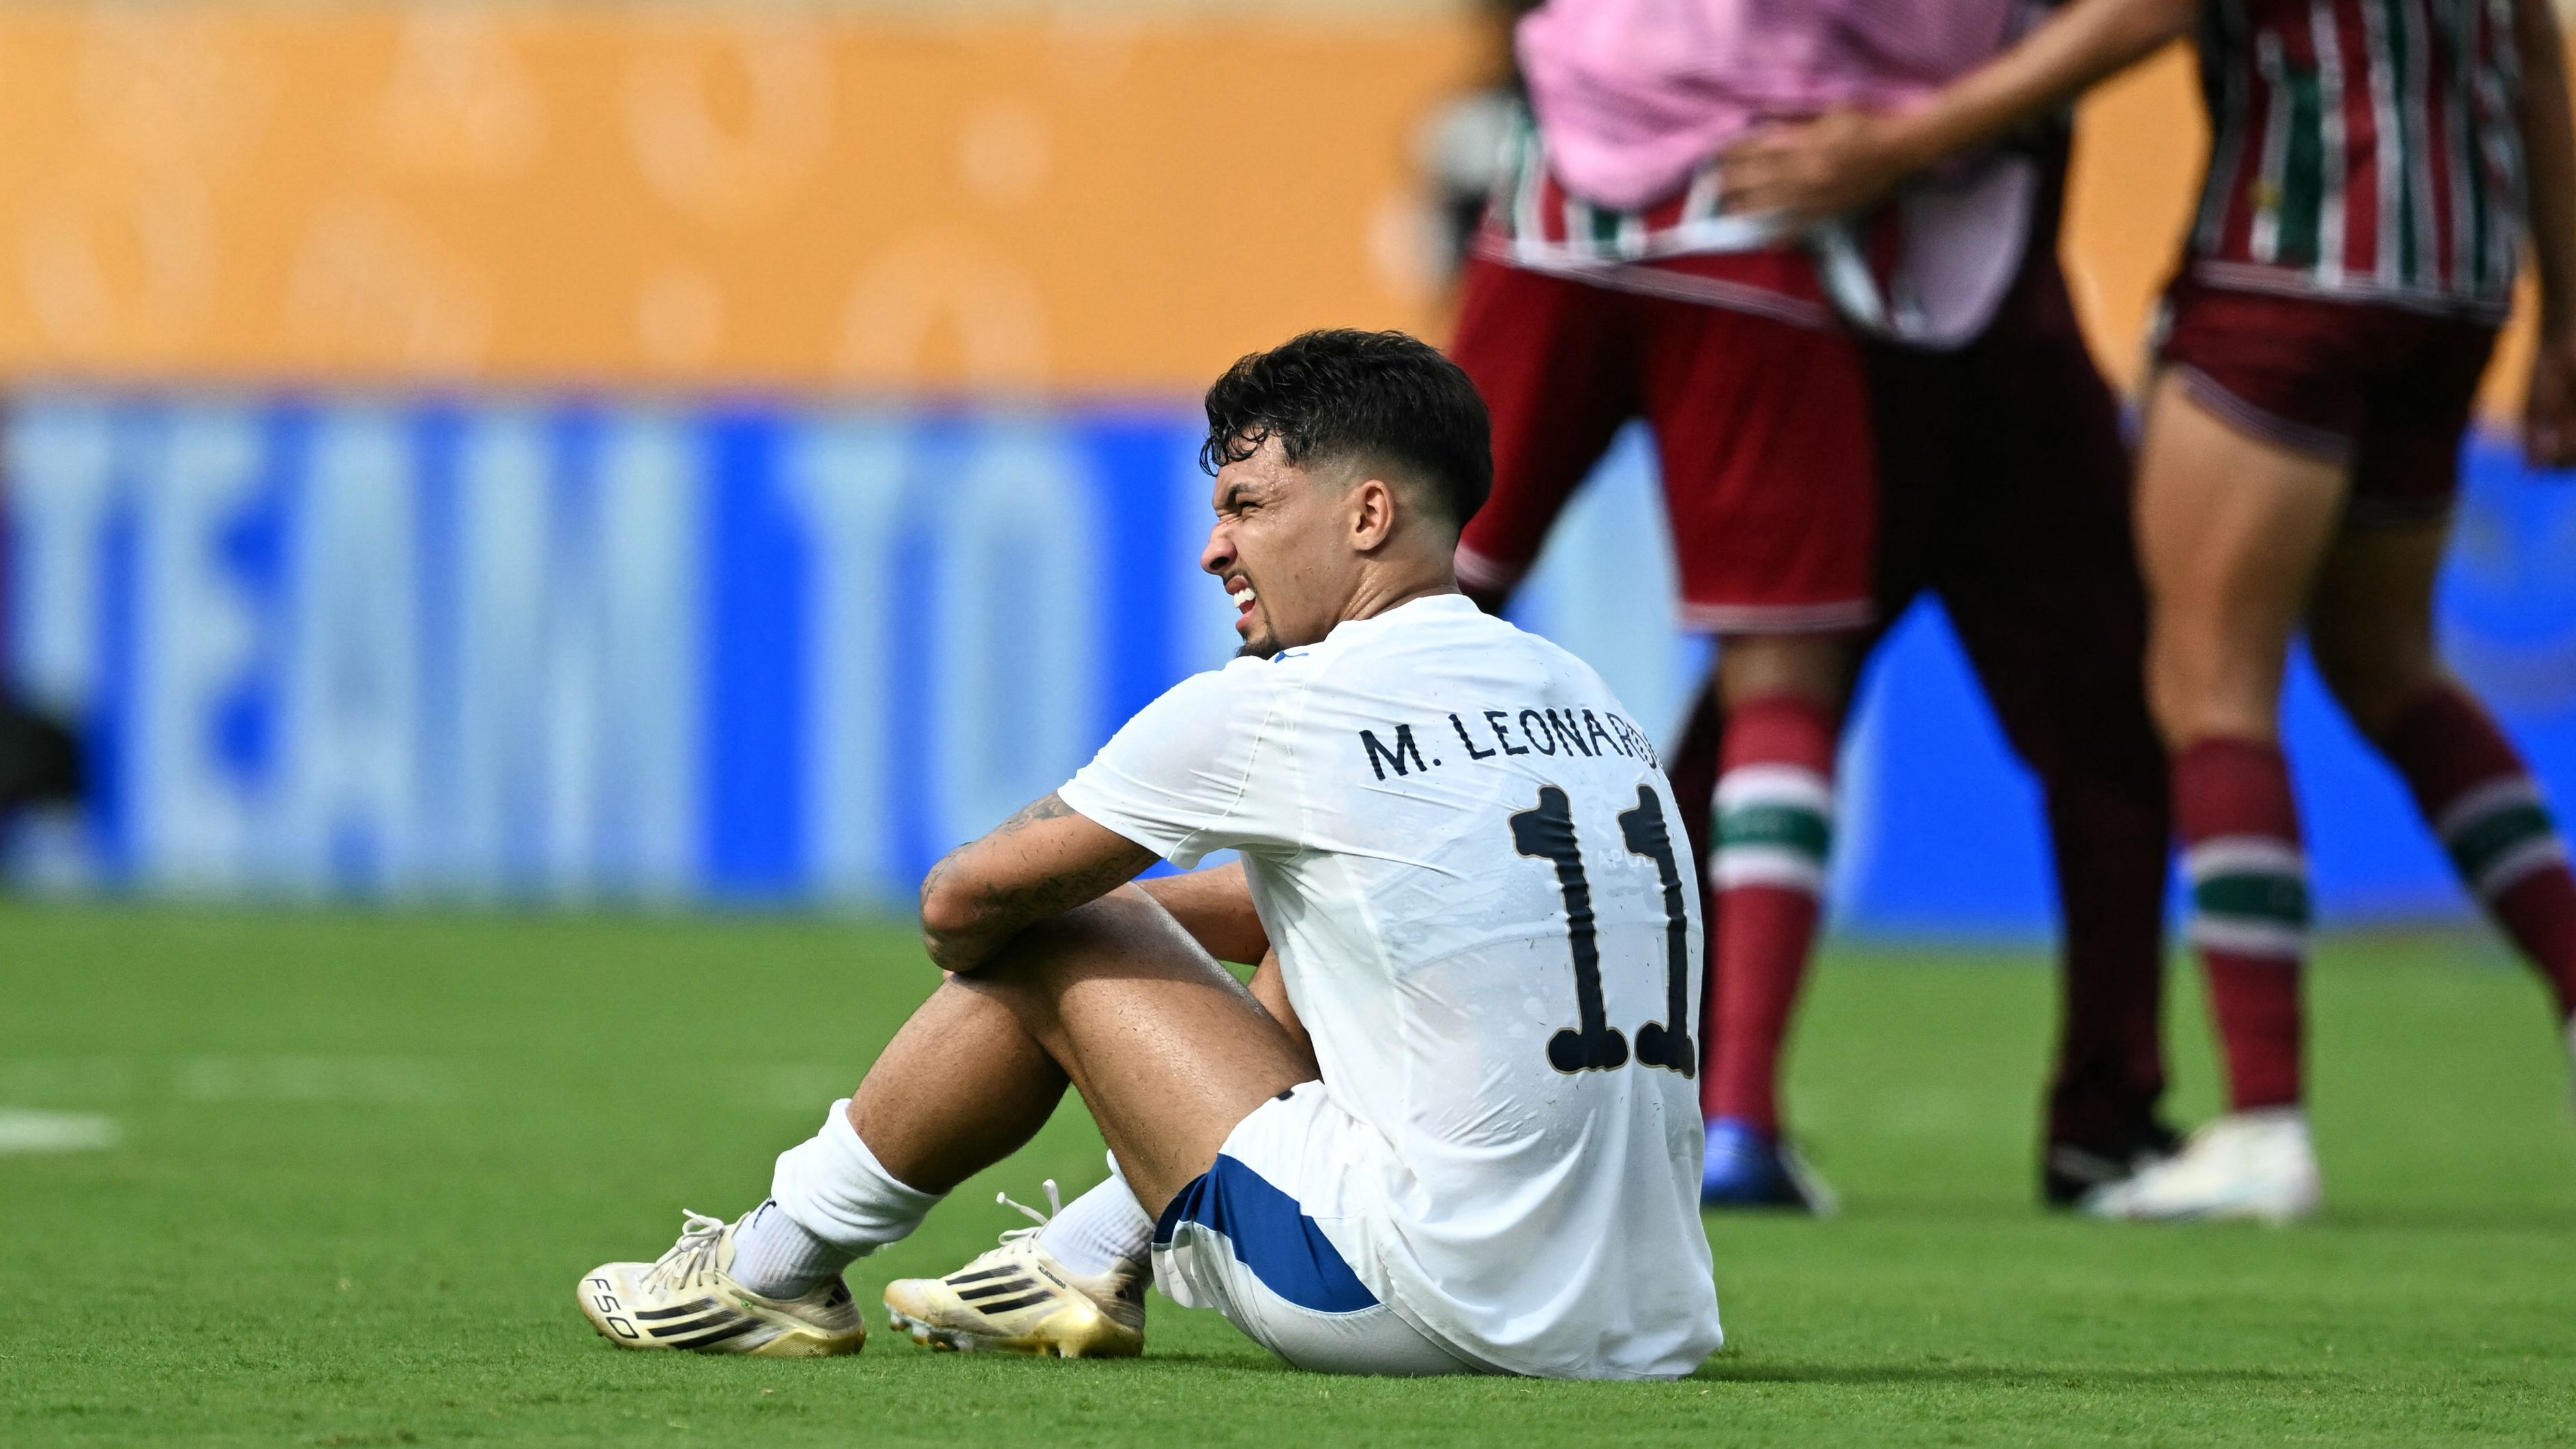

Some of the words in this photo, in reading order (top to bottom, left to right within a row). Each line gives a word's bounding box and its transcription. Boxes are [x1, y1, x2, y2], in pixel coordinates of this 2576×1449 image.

[8, 402, 697, 890] TEAM
[788, 406, 1100, 894] TO
[1359, 724, 1441, 780] M.
[1508, 784, 1696, 1080] 11
[585, 1278, 639, 1339] F50
